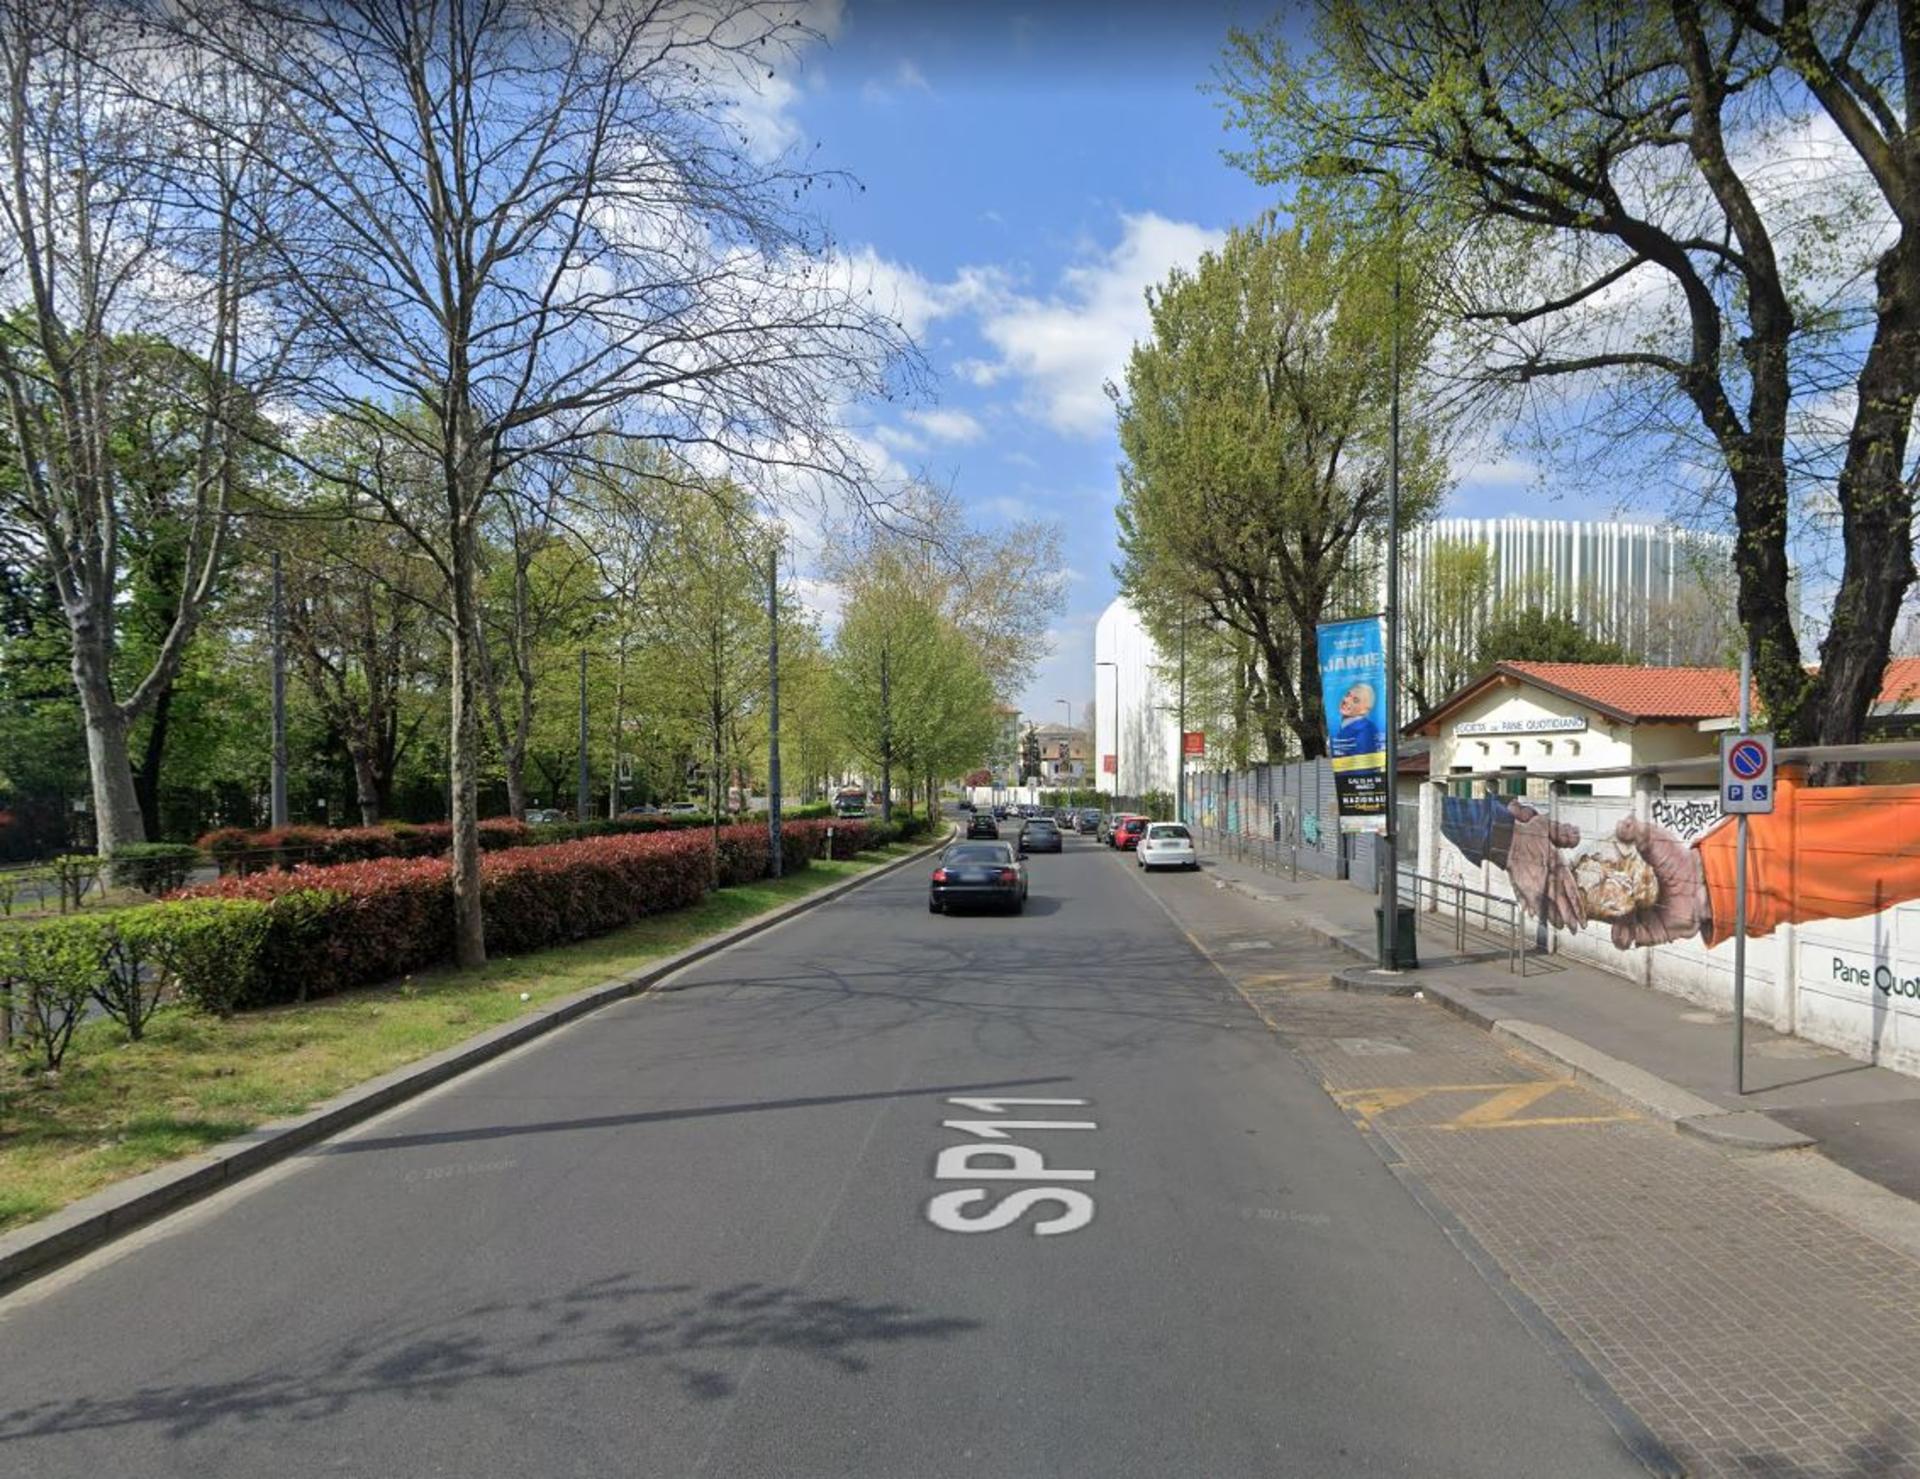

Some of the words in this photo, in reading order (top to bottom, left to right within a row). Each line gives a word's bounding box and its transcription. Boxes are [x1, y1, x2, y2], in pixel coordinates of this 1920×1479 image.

[1324, 652, 1380, 671] JAMIE
[1502, 721, 1523, 731] PANE
[1526, 716, 1584, 730] QUOTIDIANO
[1731, 786, 1740, 799] P
[1832, 957, 1870, 986] Pane
[1874, 965, 1920, 1000] Quot
